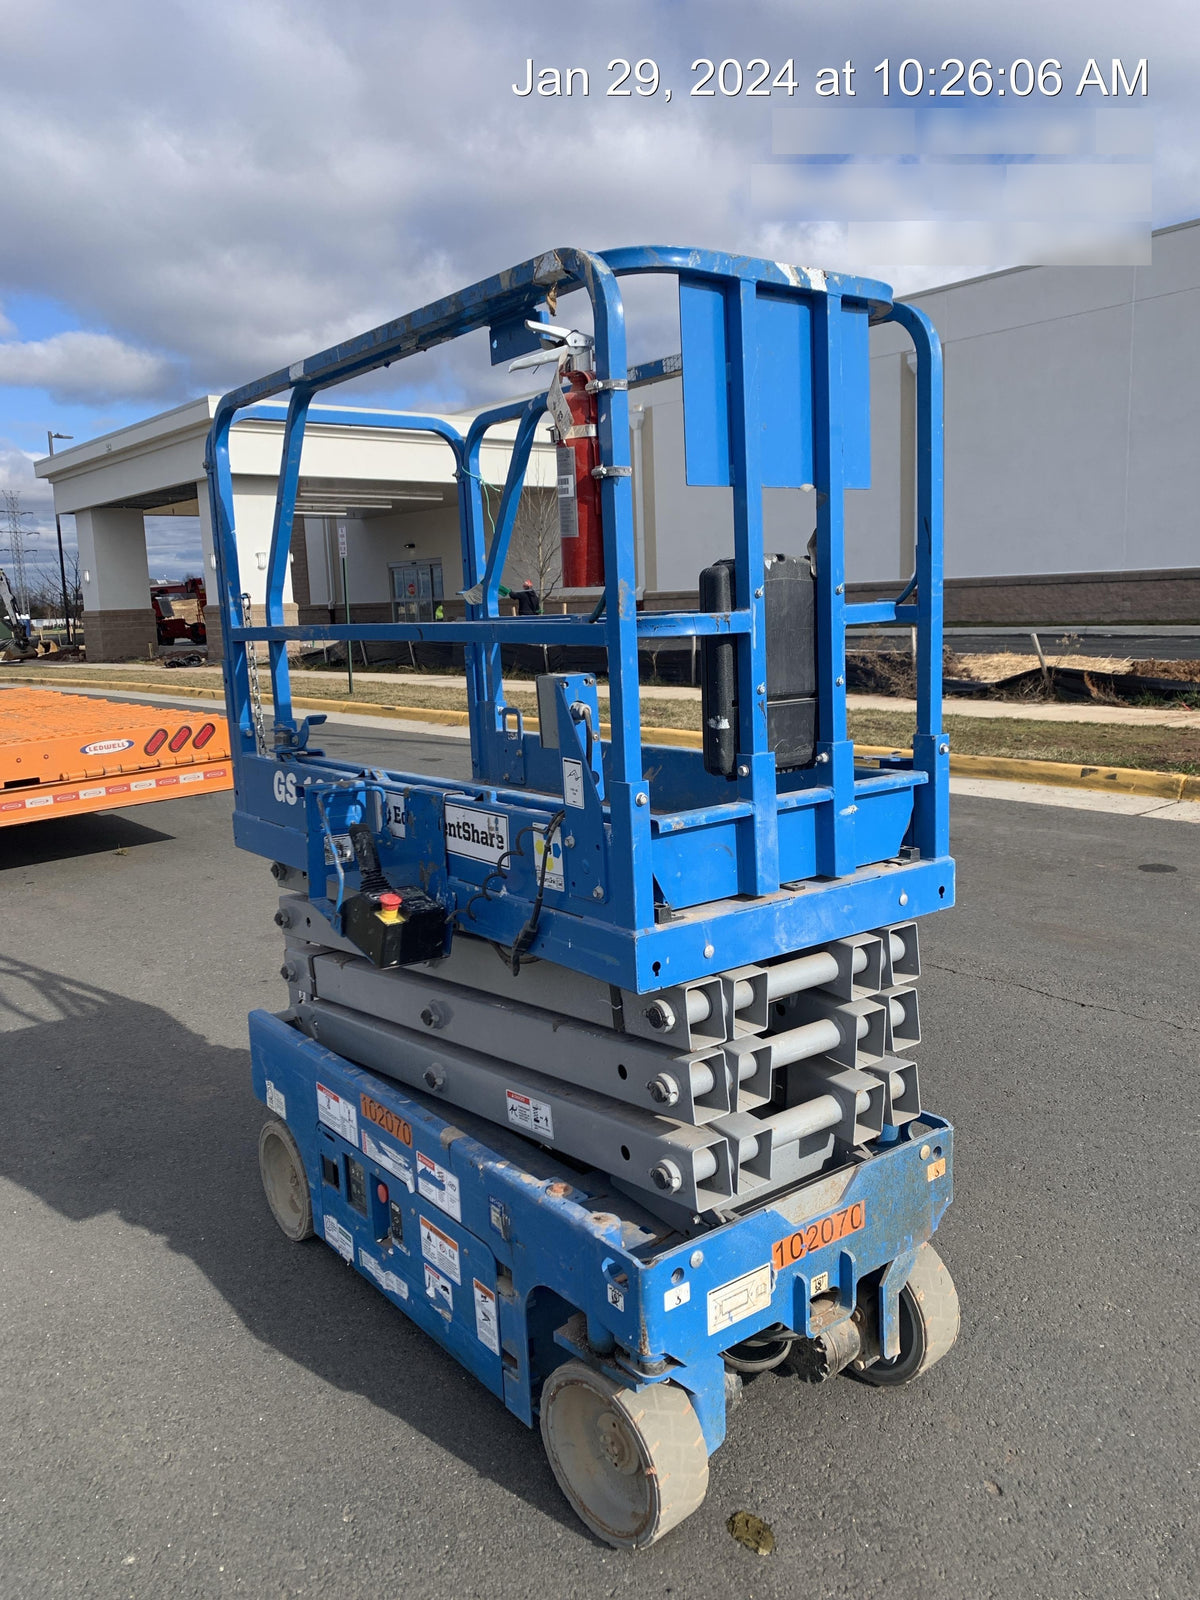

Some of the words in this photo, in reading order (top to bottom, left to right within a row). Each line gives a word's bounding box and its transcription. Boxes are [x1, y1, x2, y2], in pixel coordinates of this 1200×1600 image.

[88, 741, 126, 753] LEDWELL
[273, 770, 297, 806] GS
[362, 1096, 412, 1146] 102070
[775, 1203, 862, 1267] 102070
